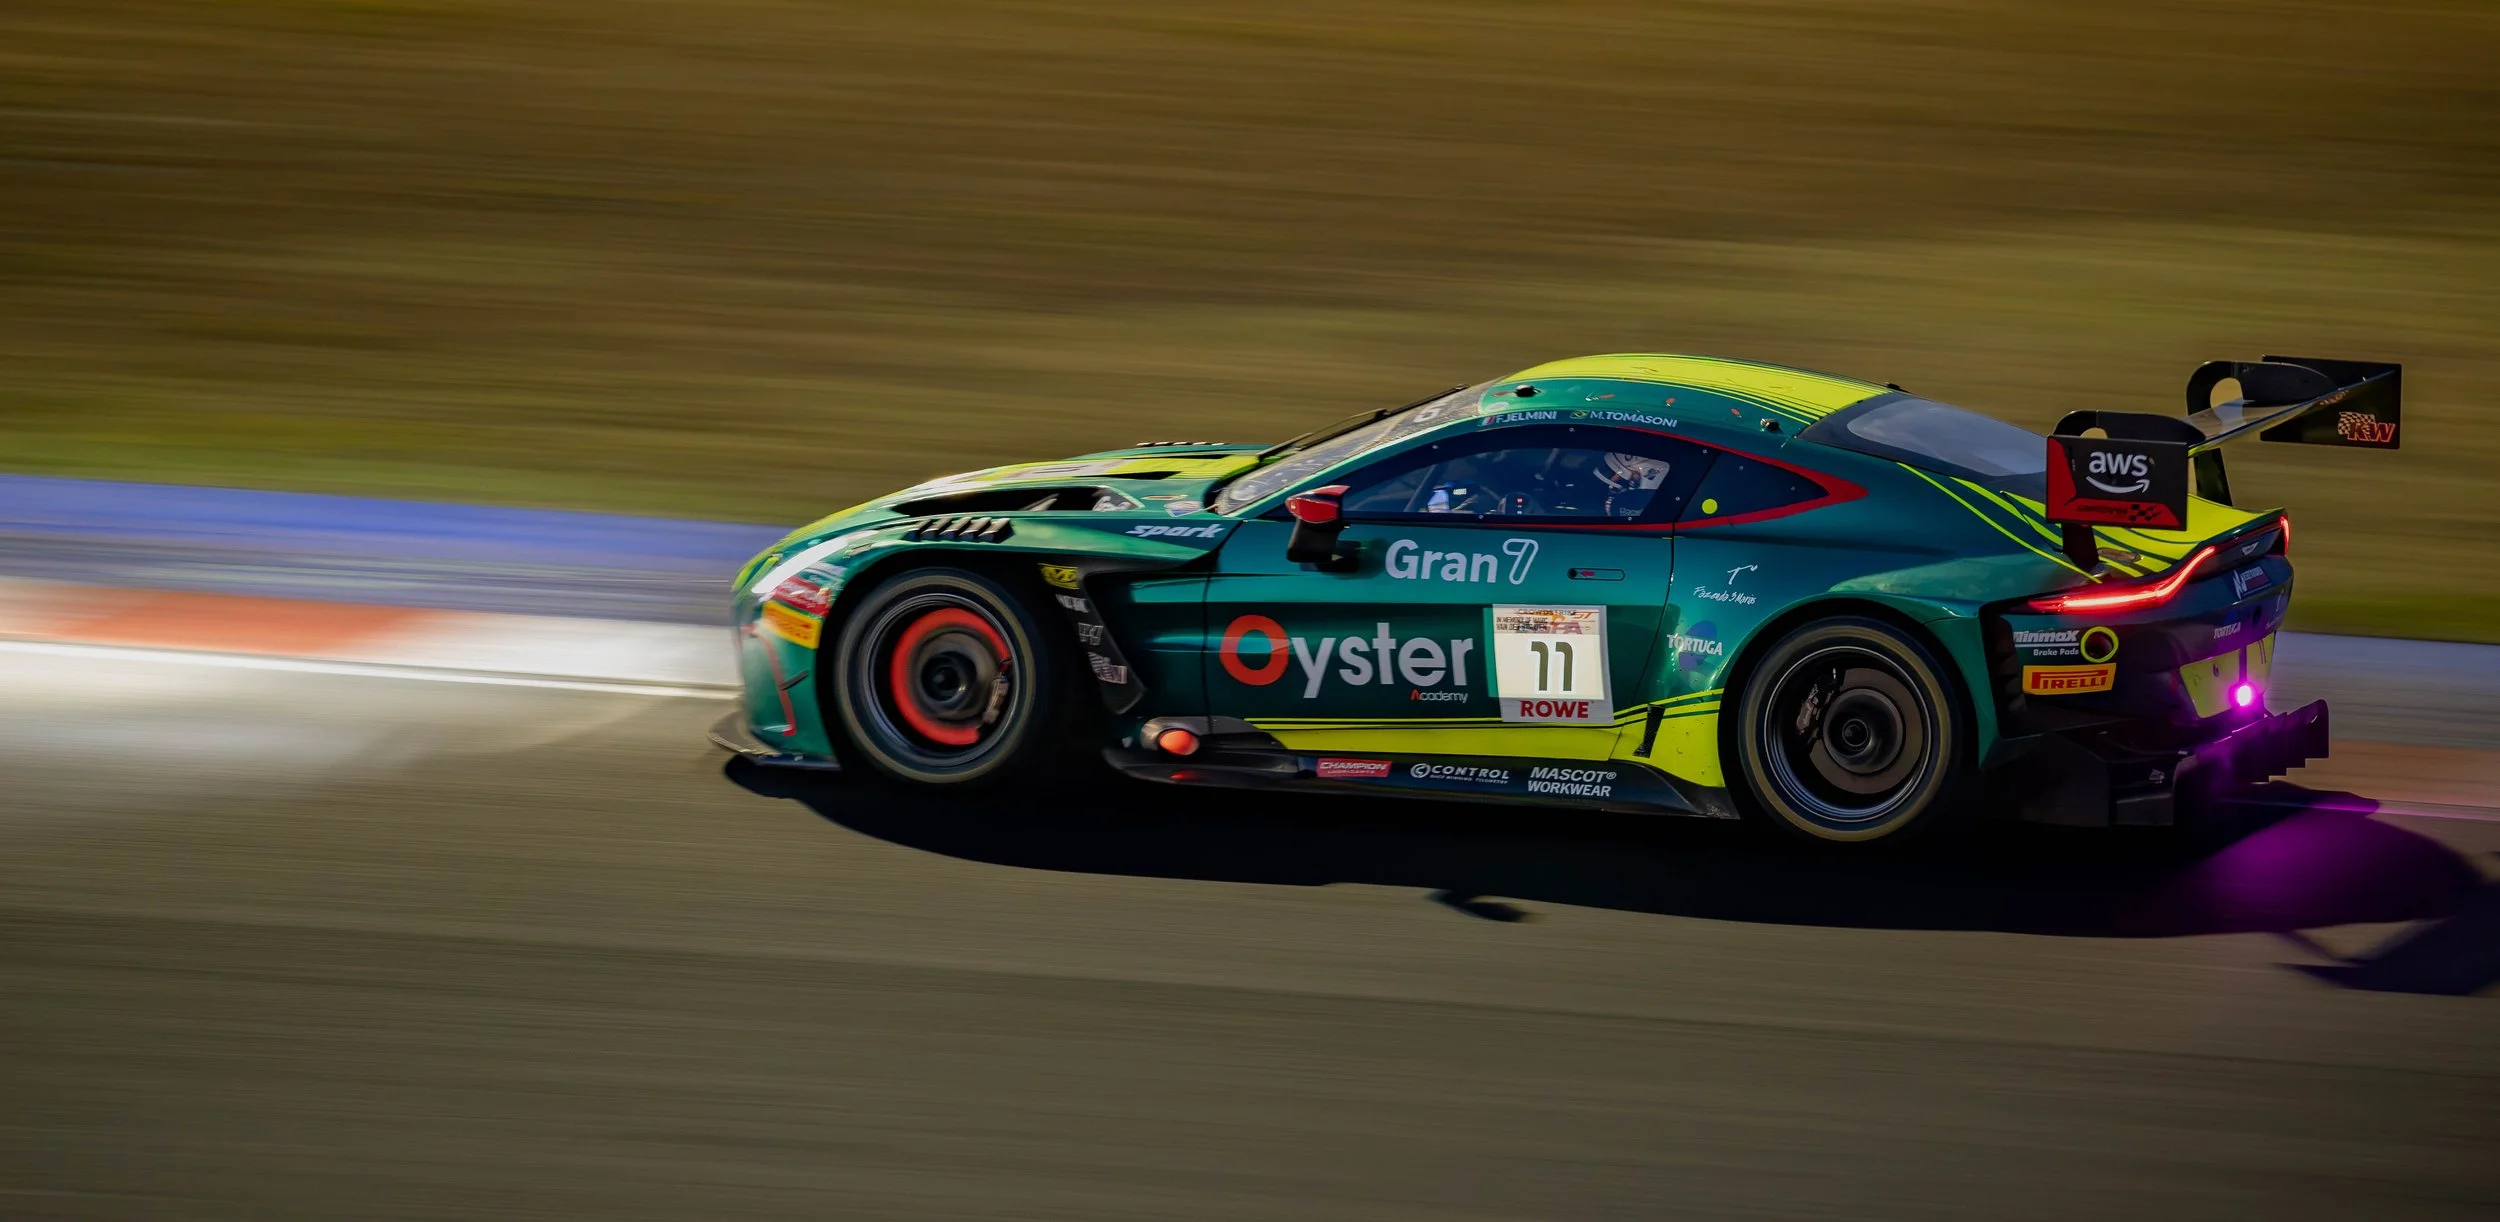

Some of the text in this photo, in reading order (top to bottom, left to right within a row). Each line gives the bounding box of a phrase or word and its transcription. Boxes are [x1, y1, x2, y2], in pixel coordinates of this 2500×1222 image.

[1590, 411, 1677, 428] M.TOMASONI
[2347, 422, 2396, 442] KW
[2089, 451, 2148, 477] aws
[1125, 524, 1225, 538] spark
[1667, 634, 1723, 655] TORTUGA
[2060, 648, 2080, 656] Pads
[1219, 614, 1474, 699] Oyster
[1531, 641, 1573, 691] 11
[2031, 669, 2109, 690] PIRELLI
[1411, 688, 1468, 703] Academy
[1520, 701, 1589, 718] ROWE
[1320, 761, 1388, 770] CHAMPION
[1528, 781, 1612, 797] WORKWEAR
